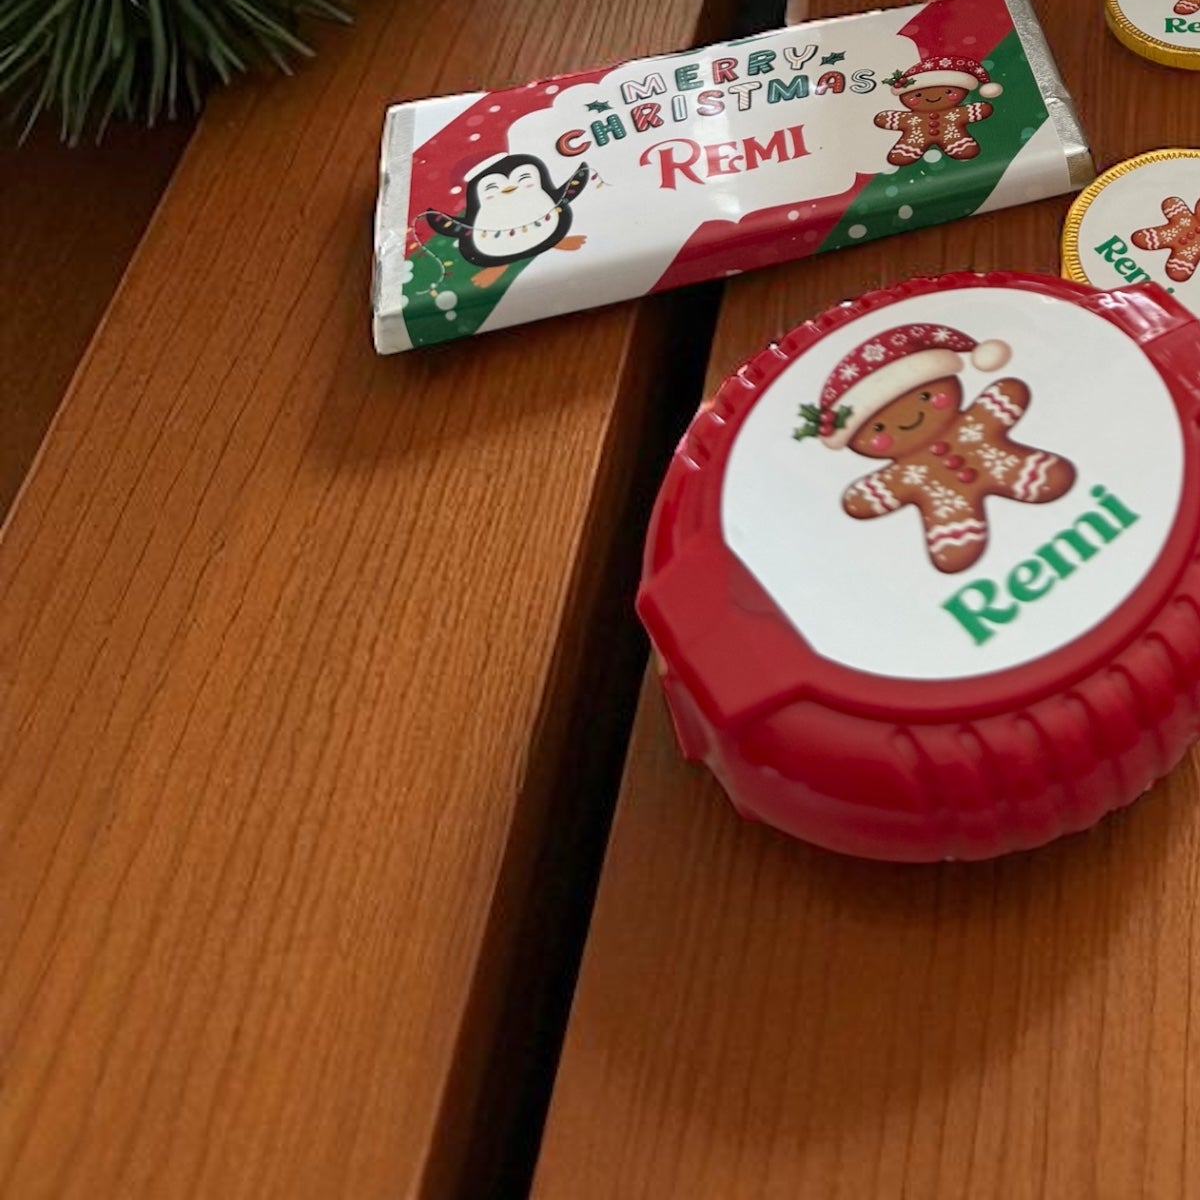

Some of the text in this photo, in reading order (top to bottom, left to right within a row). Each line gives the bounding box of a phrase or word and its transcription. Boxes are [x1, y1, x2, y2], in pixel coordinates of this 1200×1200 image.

[621, 44, 818, 104] MERRY
[556, 68, 877, 157] CHRISTMAS
[639, 124, 812, 190] REMI
[1094, 234, 1175, 294] Re
[942, 485, 1141, 646] Remi
